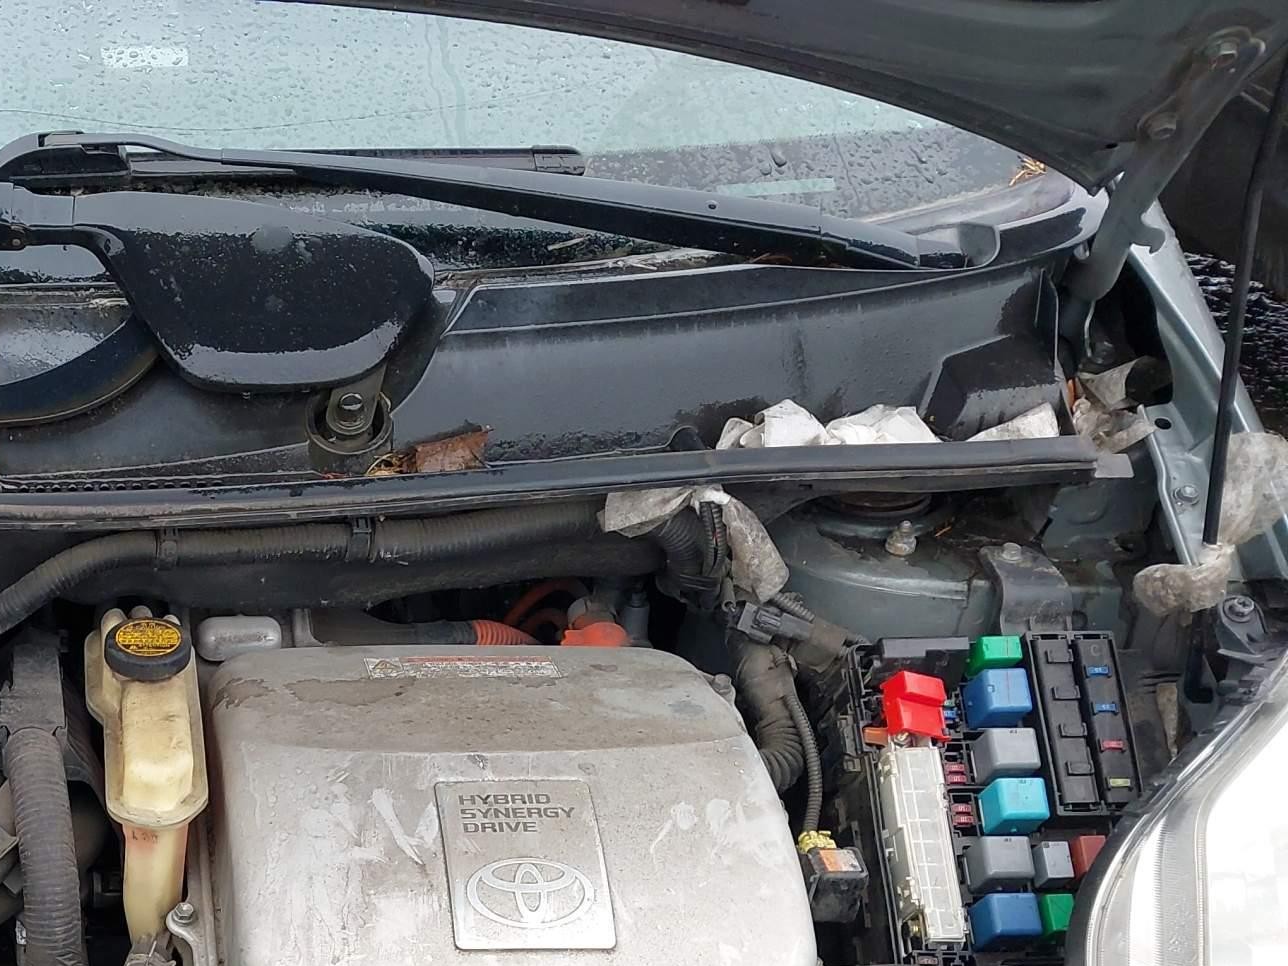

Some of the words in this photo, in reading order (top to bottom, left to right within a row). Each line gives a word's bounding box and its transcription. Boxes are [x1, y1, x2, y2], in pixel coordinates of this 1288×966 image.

[458, 793, 551, 805] HYBRID
[460, 807, 575, 819] SYNERGY
[462, 821, 538, 833] DRIVE
